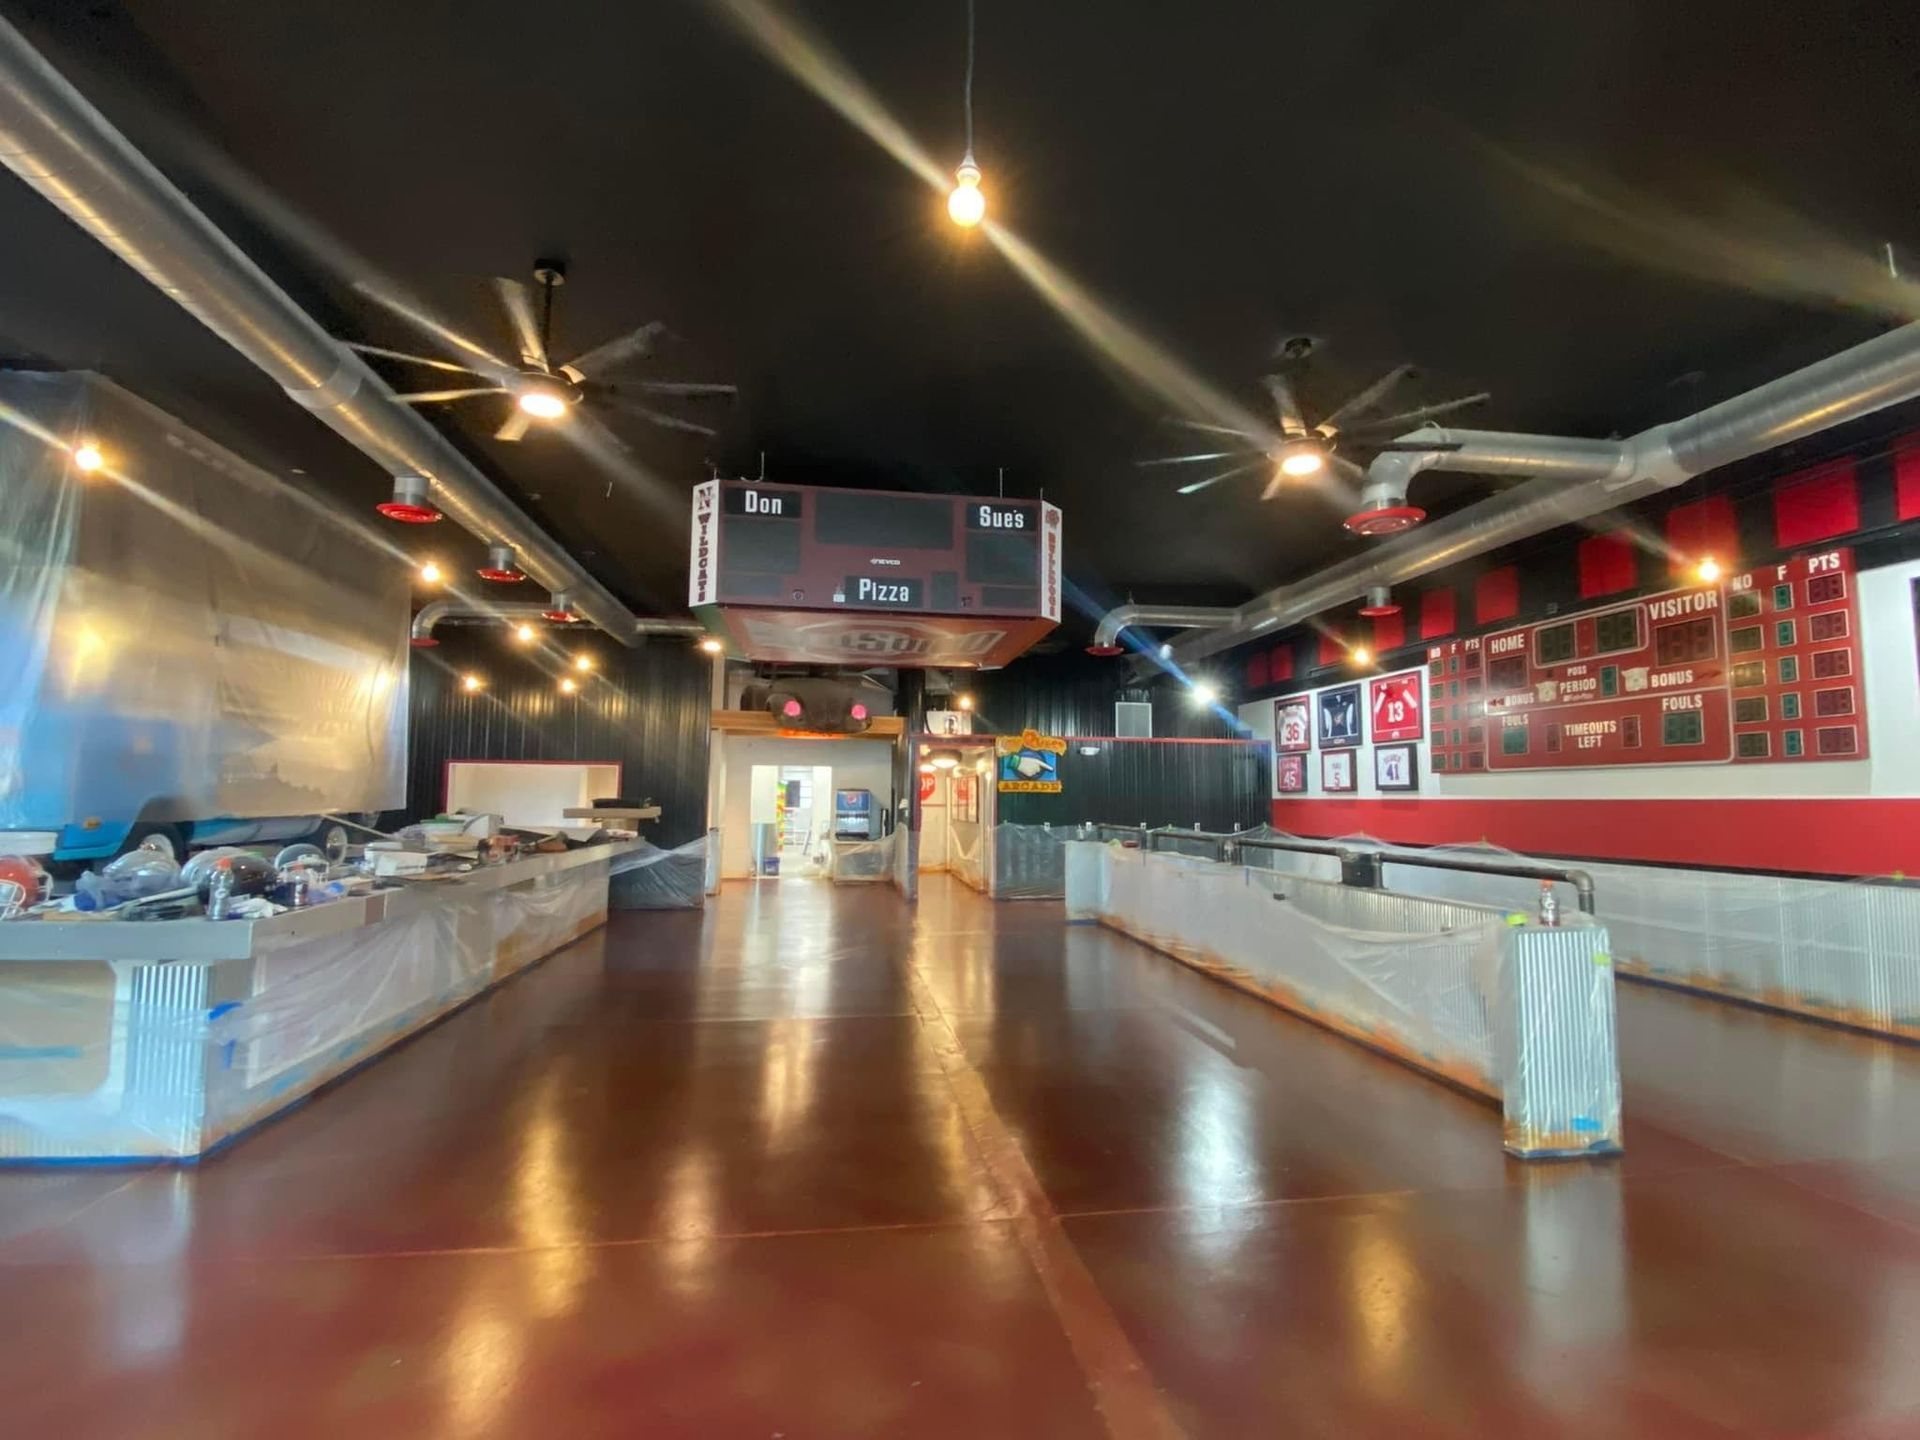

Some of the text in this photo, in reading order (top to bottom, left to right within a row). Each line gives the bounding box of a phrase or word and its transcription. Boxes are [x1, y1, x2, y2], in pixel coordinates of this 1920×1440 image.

[745, 490, 783, 515] Don
[979, 506, 1025, 528] Sue's
[697, 512, 711, 603] WILDCATS
[1809, 552, 1840, 574] PTS
[1777, 565, 1788, 581] F
[859, 578, 910, 602] Pizza
[1732, 574, 1752, 591] NO
[1649, 590, 1718, 621] VISITOR
[1451, 644, 1457, 654] F
[1465, 638, 1480, 651] PTS
[1491, 633, 1525, 654] HOME
[1560, 678, 1597, 693] PERIOD
[1651, 670, 1694, 687] BONUS
[1505, 693, 1534, 706] BONUS
[1662, 694, 1703, 711] FOULS
[1387, 701, 1404, 723] 13
[1502, 714, 1529, 727] FOULS
[1286, 722, 1300, 741] 36
[1565, 720, 1616, 735] TIMEOUTS
[1578, 735, 1602, 748] LEFT
